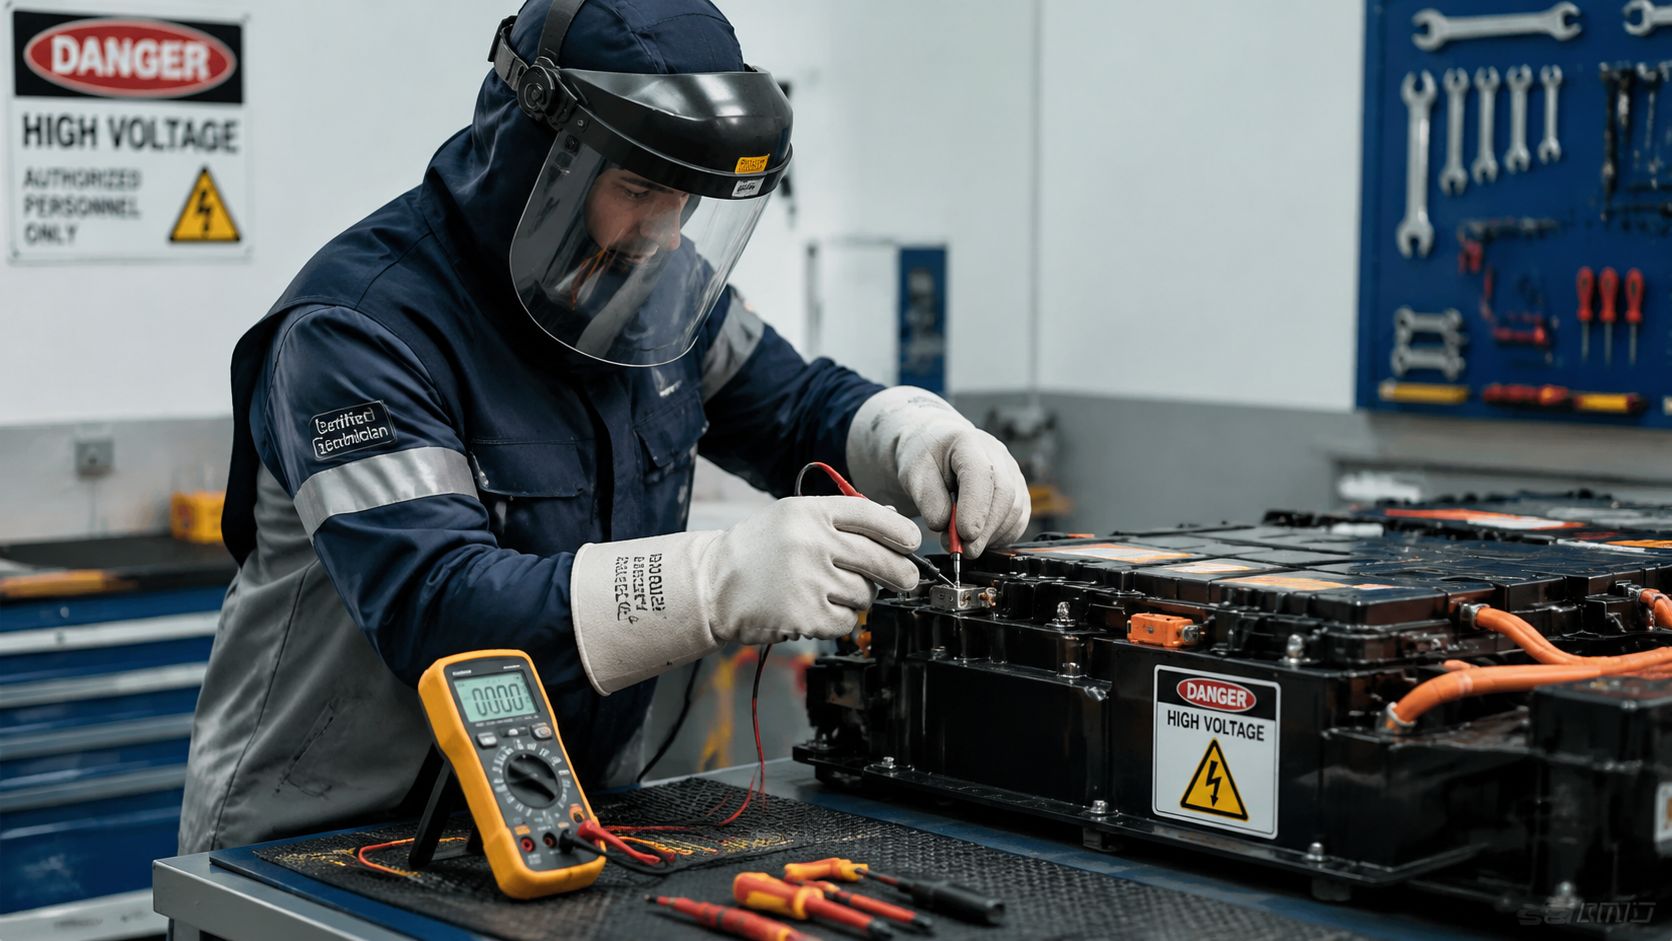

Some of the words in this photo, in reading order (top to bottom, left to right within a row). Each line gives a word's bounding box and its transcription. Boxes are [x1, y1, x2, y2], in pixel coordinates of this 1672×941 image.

[51, 35, 211, 80] DANGER
[22, 114, 98, 148] HIGH
[108, 117, 239, 153] VOLTAGE
[24, 168, 141, 190] AUTHORIZED
[24, 195, 140, 219] PERSONNEL
[25, 224, 77, 245] ONLY
[1186, 682, 1247, 708] DANGER
[1167, 710, 1200, 730] HIGH
[1204, 715, 1265, 742] VOLTAGE
